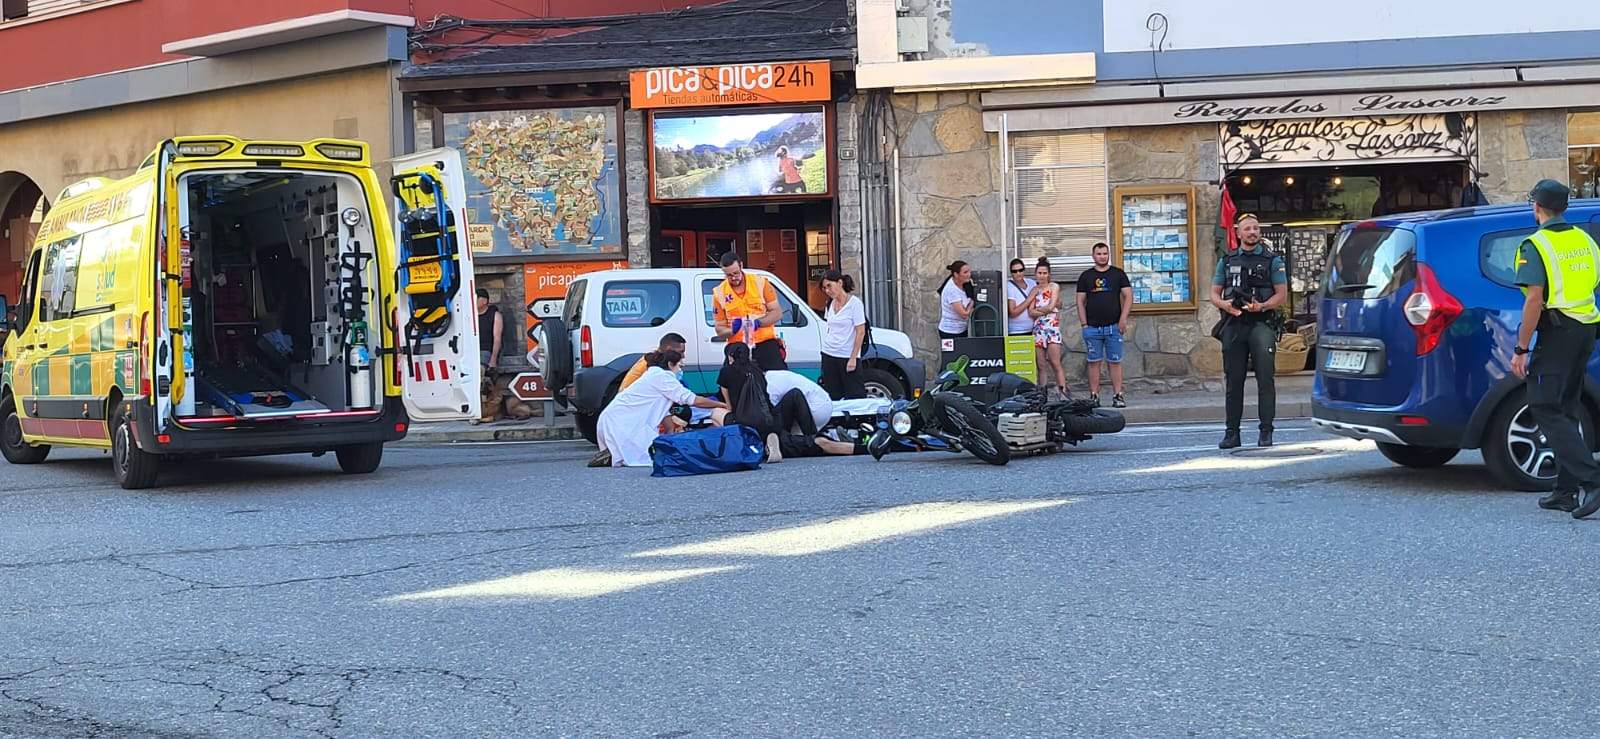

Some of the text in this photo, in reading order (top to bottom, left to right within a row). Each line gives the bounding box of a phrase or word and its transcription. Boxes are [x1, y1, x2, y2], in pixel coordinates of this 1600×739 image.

[774, 66, 814, 88] 24h
[663, 92, 758, 104] Tiendas automáticas
[1174, 95, 1506, 121] Regalos Lascorz
[1252, 118, 1444, 150] Regalos Lascorz
[543, 304, 550, 314] 6
[969, 359, 1004, 368] ZONA
[970, 376, 987, 385] ZE
[522, 382, 537, 391] 48
